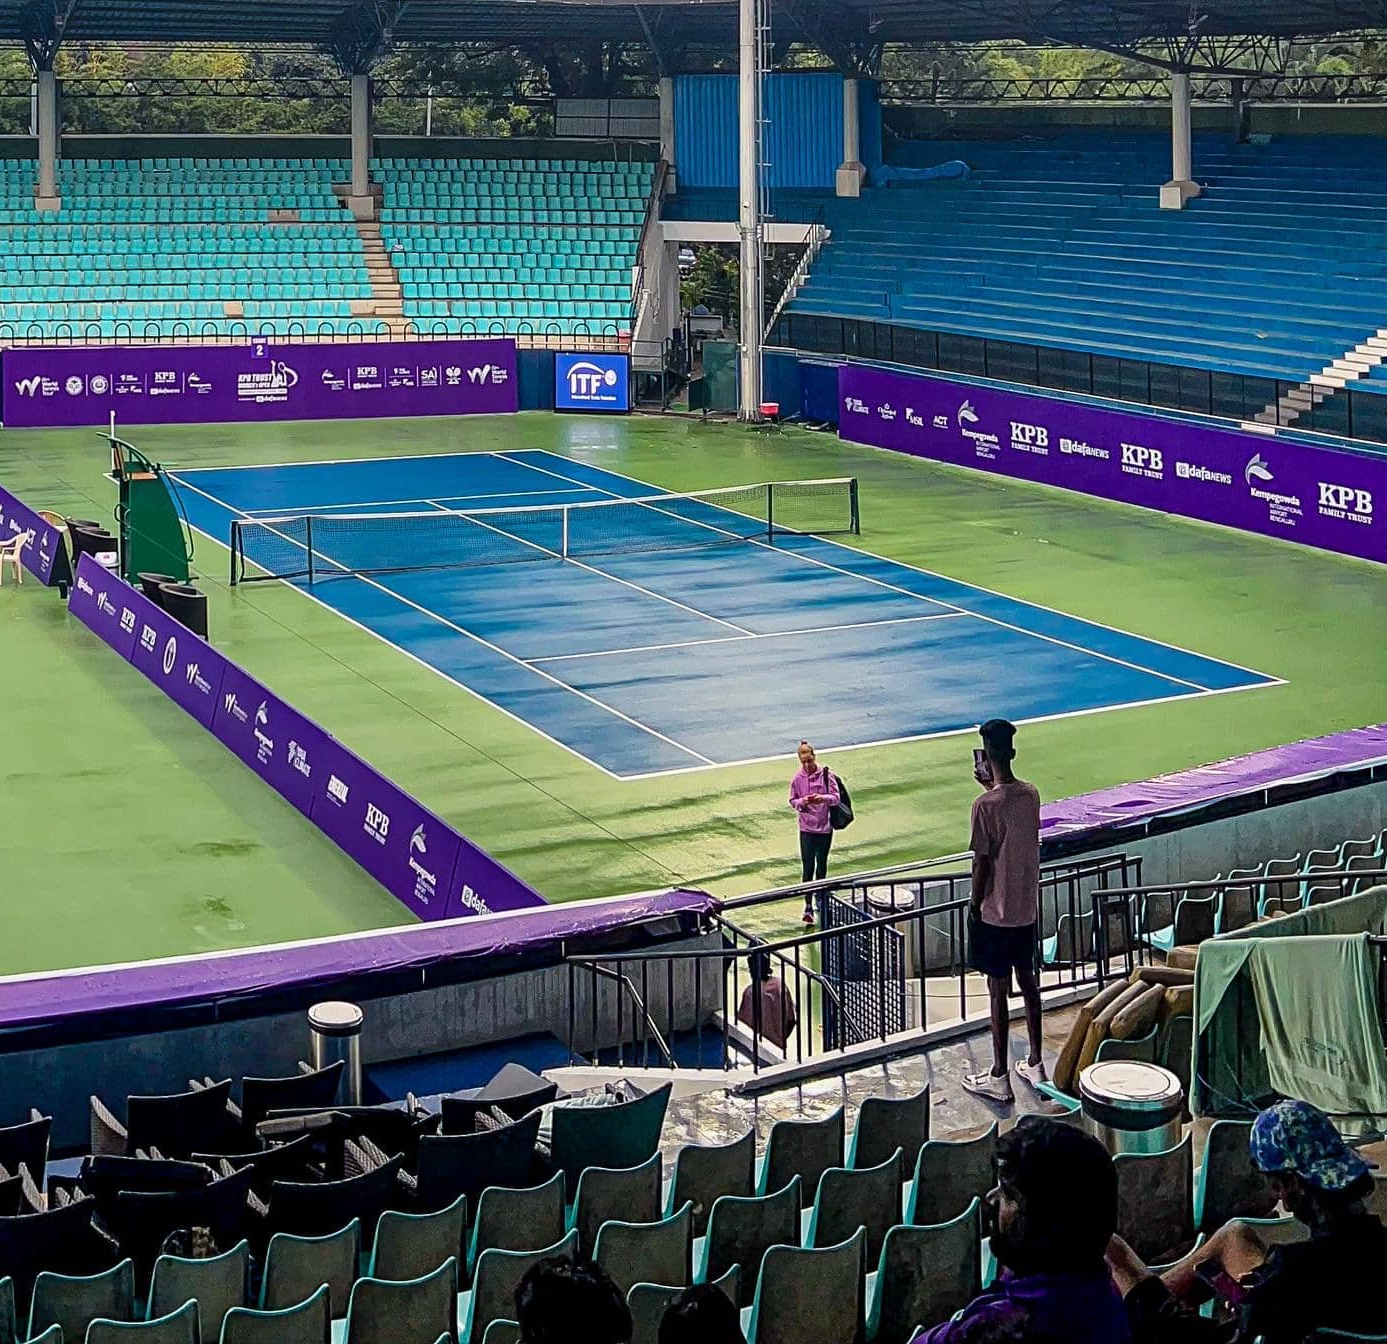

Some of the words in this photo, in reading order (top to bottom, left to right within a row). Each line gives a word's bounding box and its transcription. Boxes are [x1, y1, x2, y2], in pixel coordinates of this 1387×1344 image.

[256, 344, 264, 356] 2
[571, 373, 602, 394] ITF
[934, 415, 948, 425] ACT
[1010, 421, 1049, 447] KPB
[1121, 443, 1164, 470] KPB
[1189, 464, 1232, 485] dafaNEWS
[1250, 487, 1300, 506] Kempegowda
[1317, 481, 1373, 514] KPB
[1319, 507, 1346, 519] FAMILY
[1347, 512, 1372, 524] TRUST
[365, 802, 390, 836] KPB
